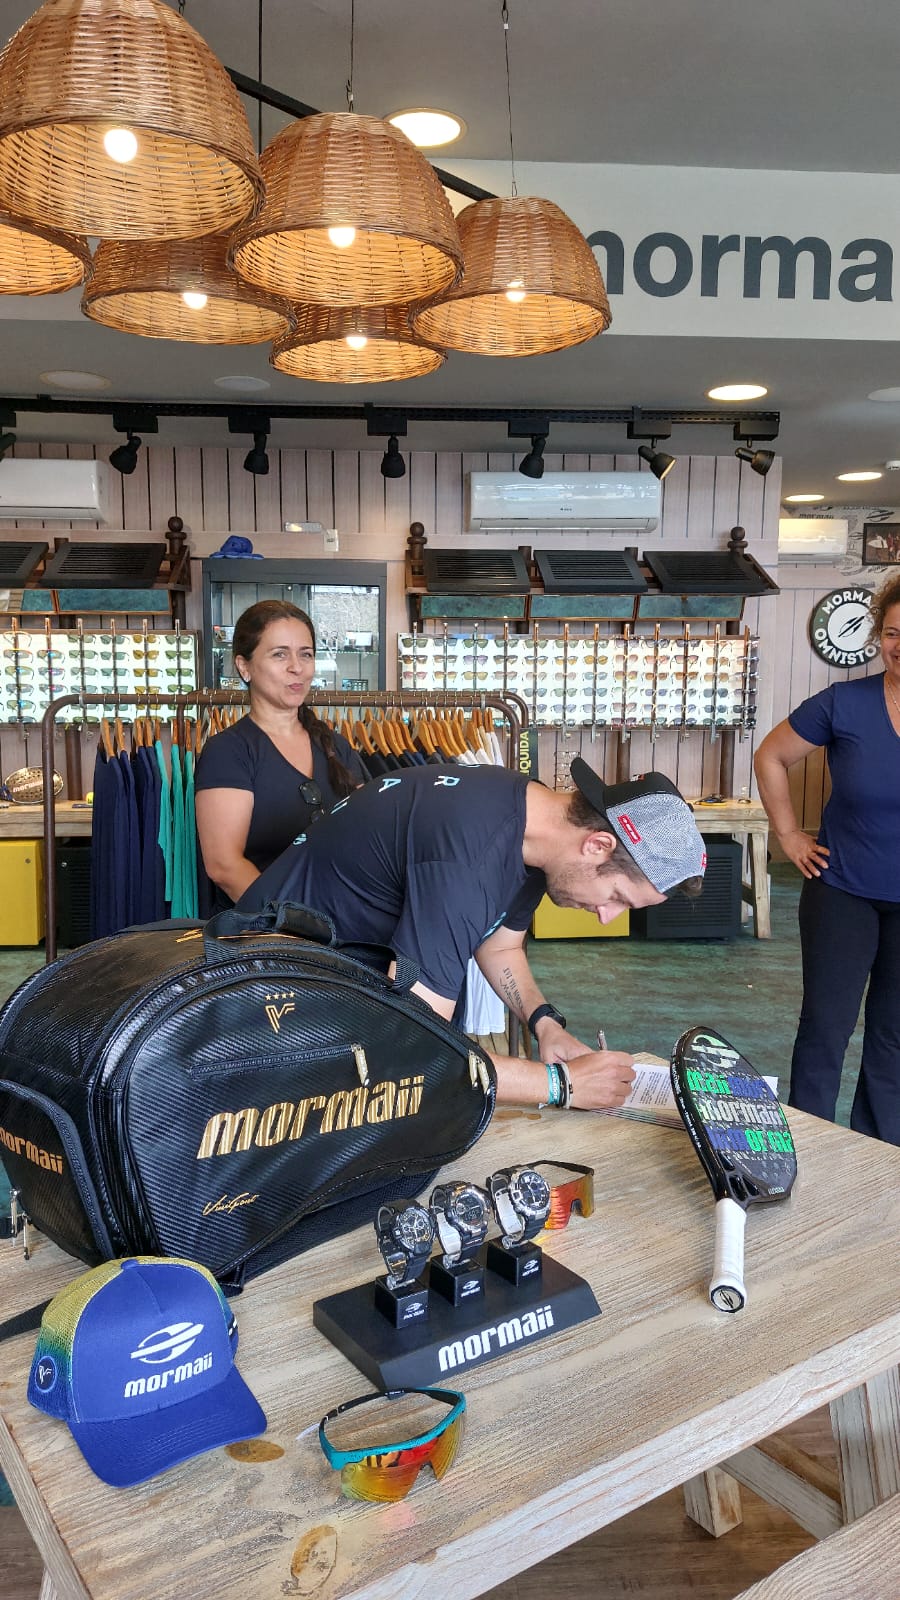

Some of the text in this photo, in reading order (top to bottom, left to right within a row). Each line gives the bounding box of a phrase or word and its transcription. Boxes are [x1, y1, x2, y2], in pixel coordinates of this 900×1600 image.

[821, 590, 872, 614] MORMA
[814, 628, 881, 665] OMNISTO
[519, 731, 531, 775] IQUIDA
[196, 1075, 425, 1159] mormaii
[438, 1304, 555, 1373] mormaii
[123, 1351, 214, 1398] mormaii
